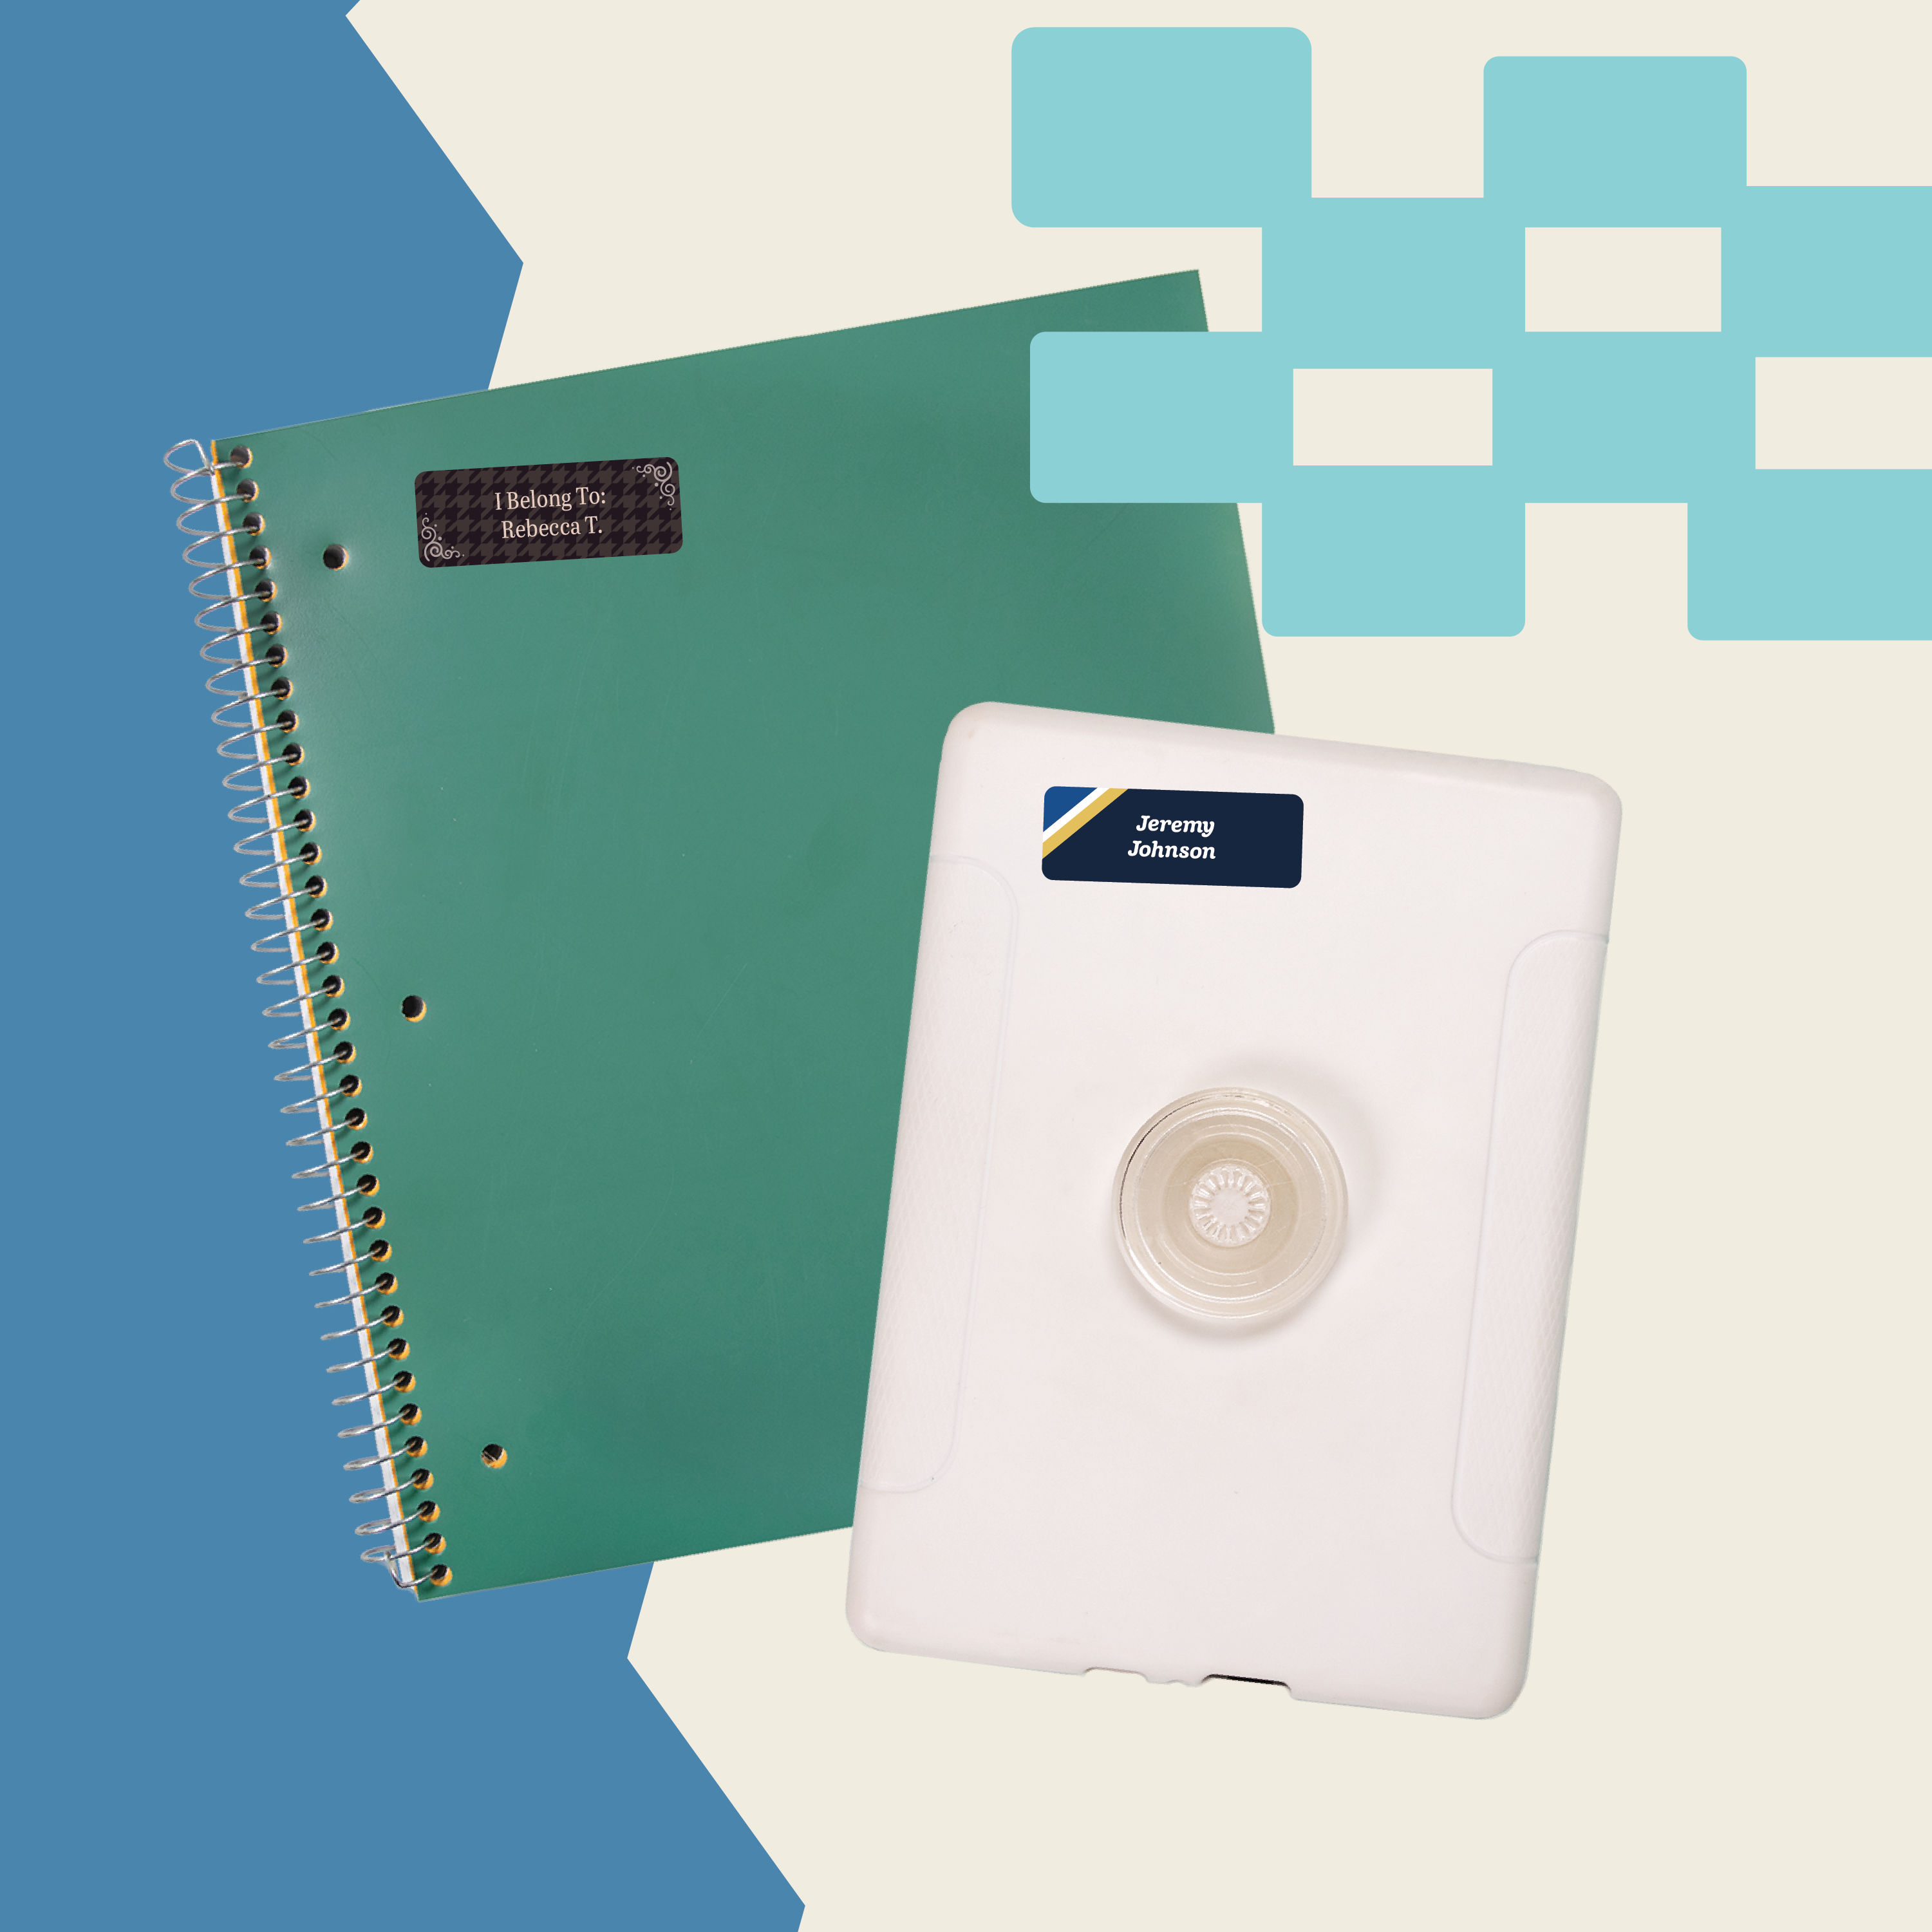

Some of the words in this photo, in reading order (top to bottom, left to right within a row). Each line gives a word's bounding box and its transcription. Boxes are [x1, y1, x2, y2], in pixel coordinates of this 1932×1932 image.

[494, 492, 502, 511] I
[506, 489, 572, 511] Belong
[576, 487, 606, 505] To:
[501, 518, 581, 539] Rebecca
[585, 516, 603, 534] T.
[1136, 815, 1215, 838] Jeremy
[1127, 840, 1216, 859] Johnson
